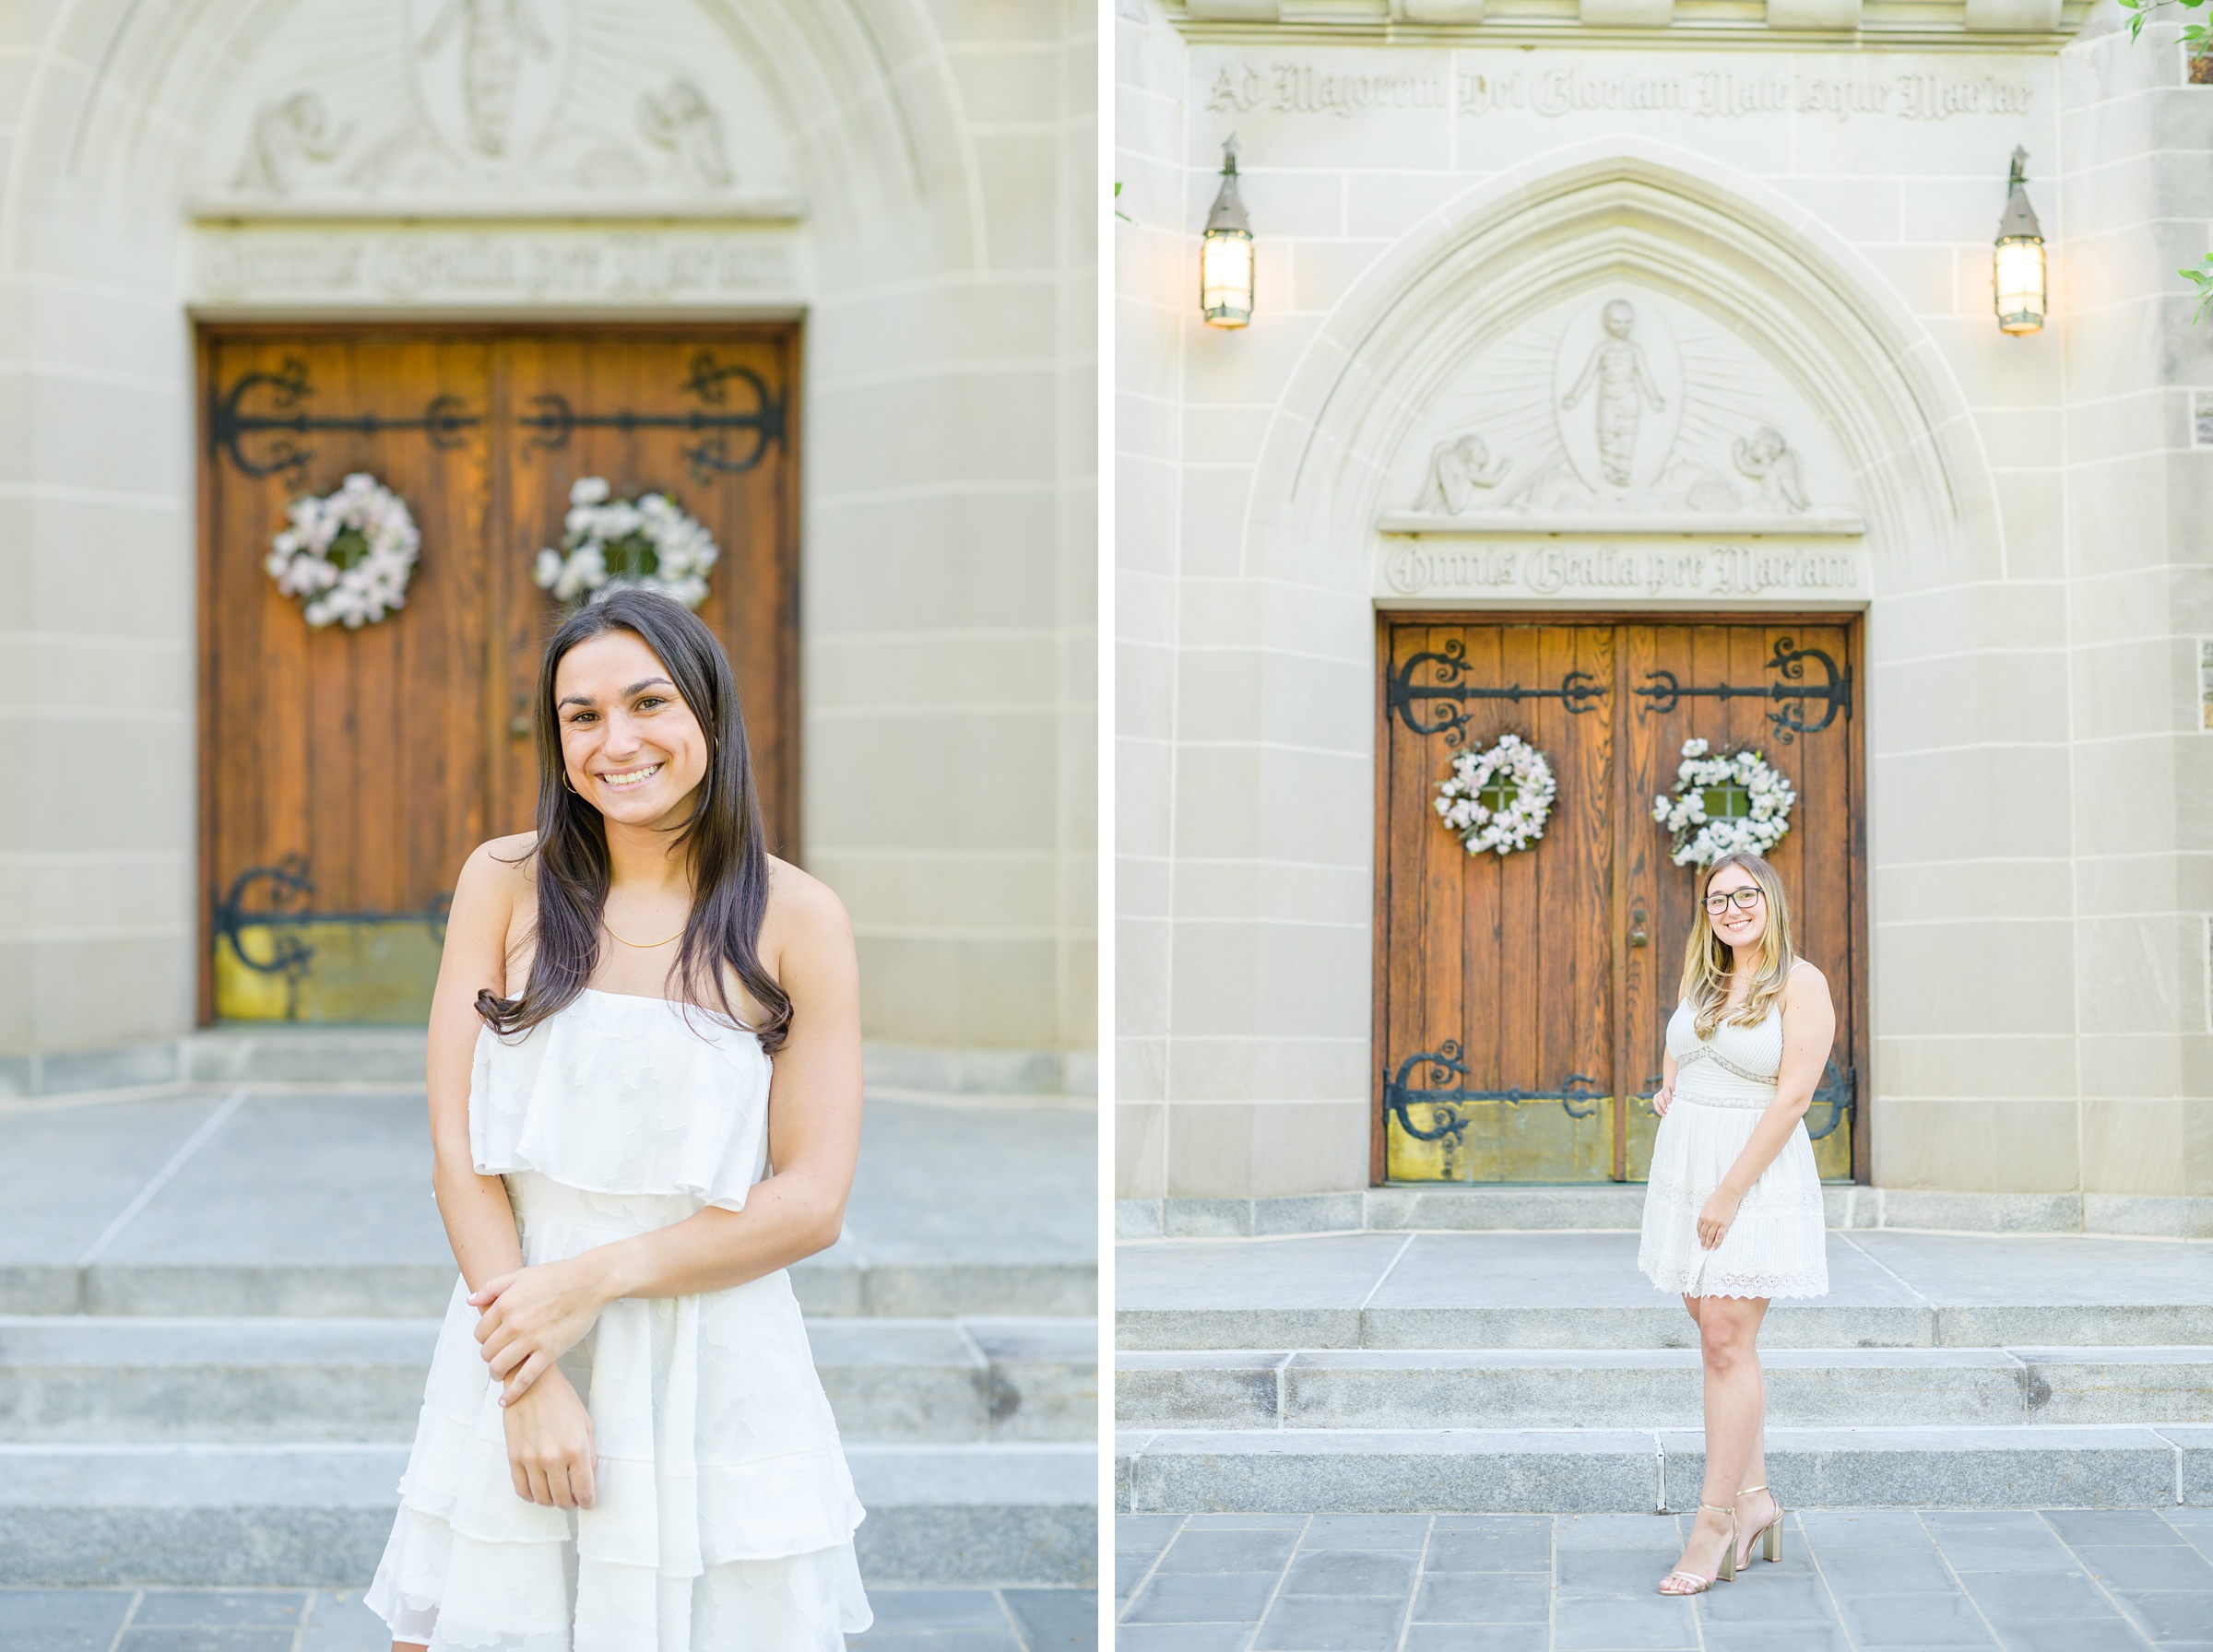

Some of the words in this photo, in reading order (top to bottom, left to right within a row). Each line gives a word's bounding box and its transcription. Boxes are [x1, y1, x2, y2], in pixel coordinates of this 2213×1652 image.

[1205, 62, 1264, 113] Ad
[1456, 68, 1524, 118] Dei
[1528, 63, 1687, 118] Gloriam
[1896, 72, 2034, 122] Mariae
[1385, 541, 1517, 595] Omnis
[1523, 545, 1641, 595] Gratia
[1645, 549, 1707, 596] per
[1710, 544, 1857, 596] Mariam
